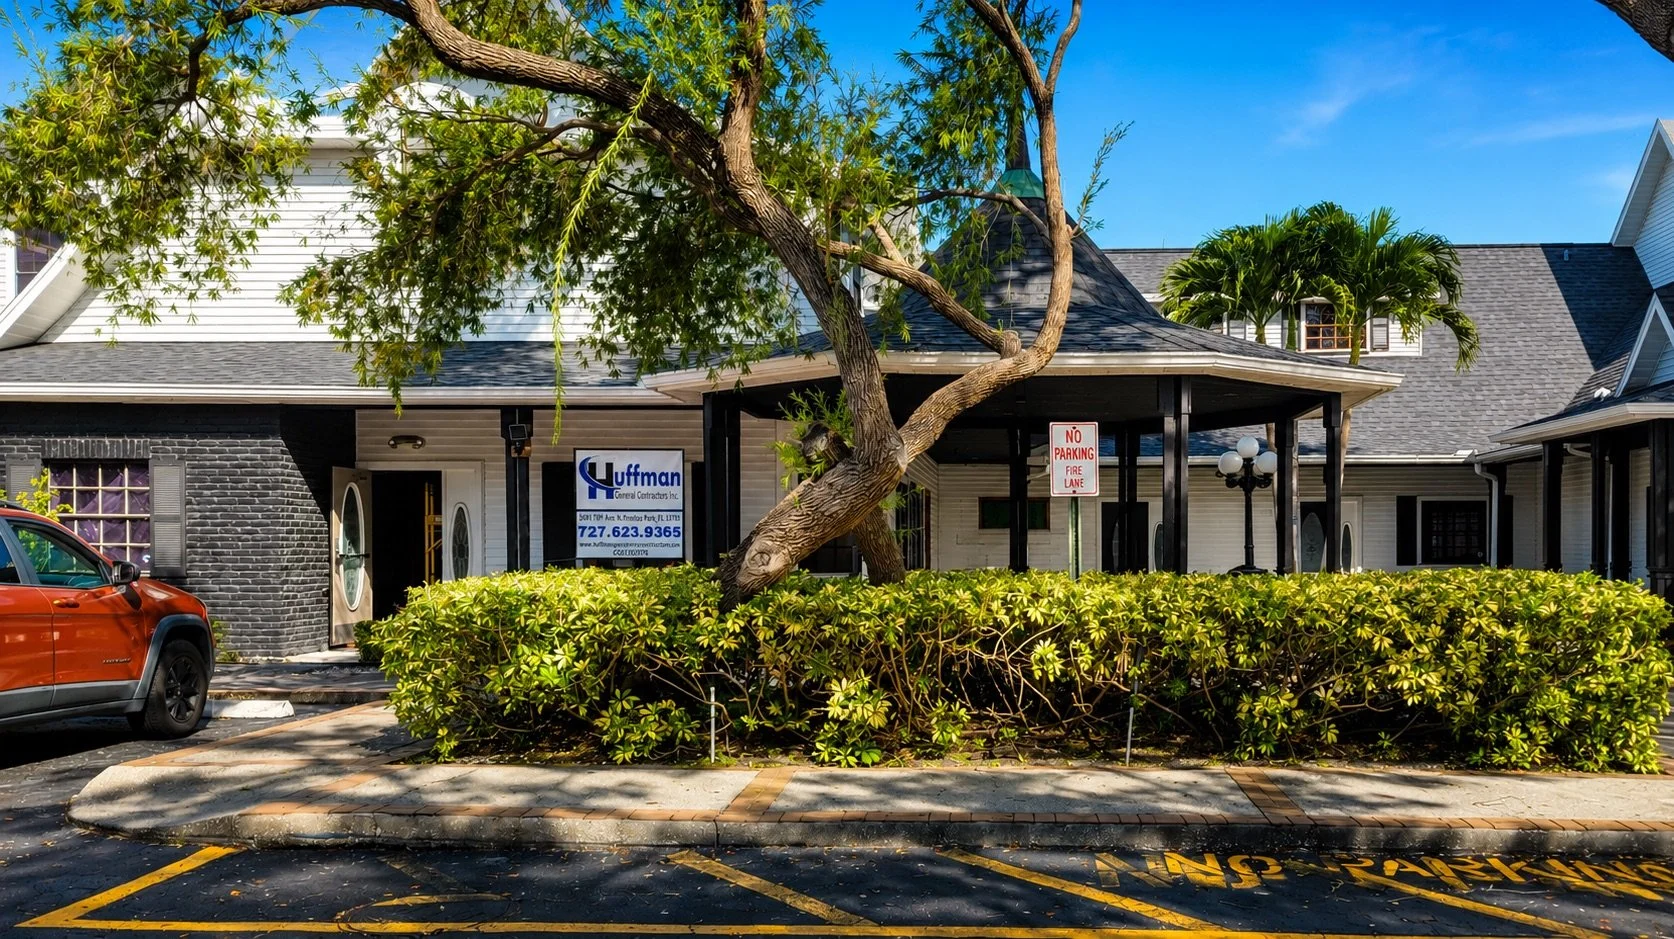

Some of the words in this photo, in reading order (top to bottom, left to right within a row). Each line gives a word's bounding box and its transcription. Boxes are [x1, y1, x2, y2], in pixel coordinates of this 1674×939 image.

[1066, 430, 1082, 443] NO
[1054, 447, 1094, 460] PARKING
[1065, 465, 1083, 476] FIRE
[586, 461, 681, 500] Huffman
[1064, 478, 1084, 489] LANE
[614, 491, 636, 500] General
[637, 491, 668, 500] Contractors
[578, 525, 682, 538] 727.623.9365
